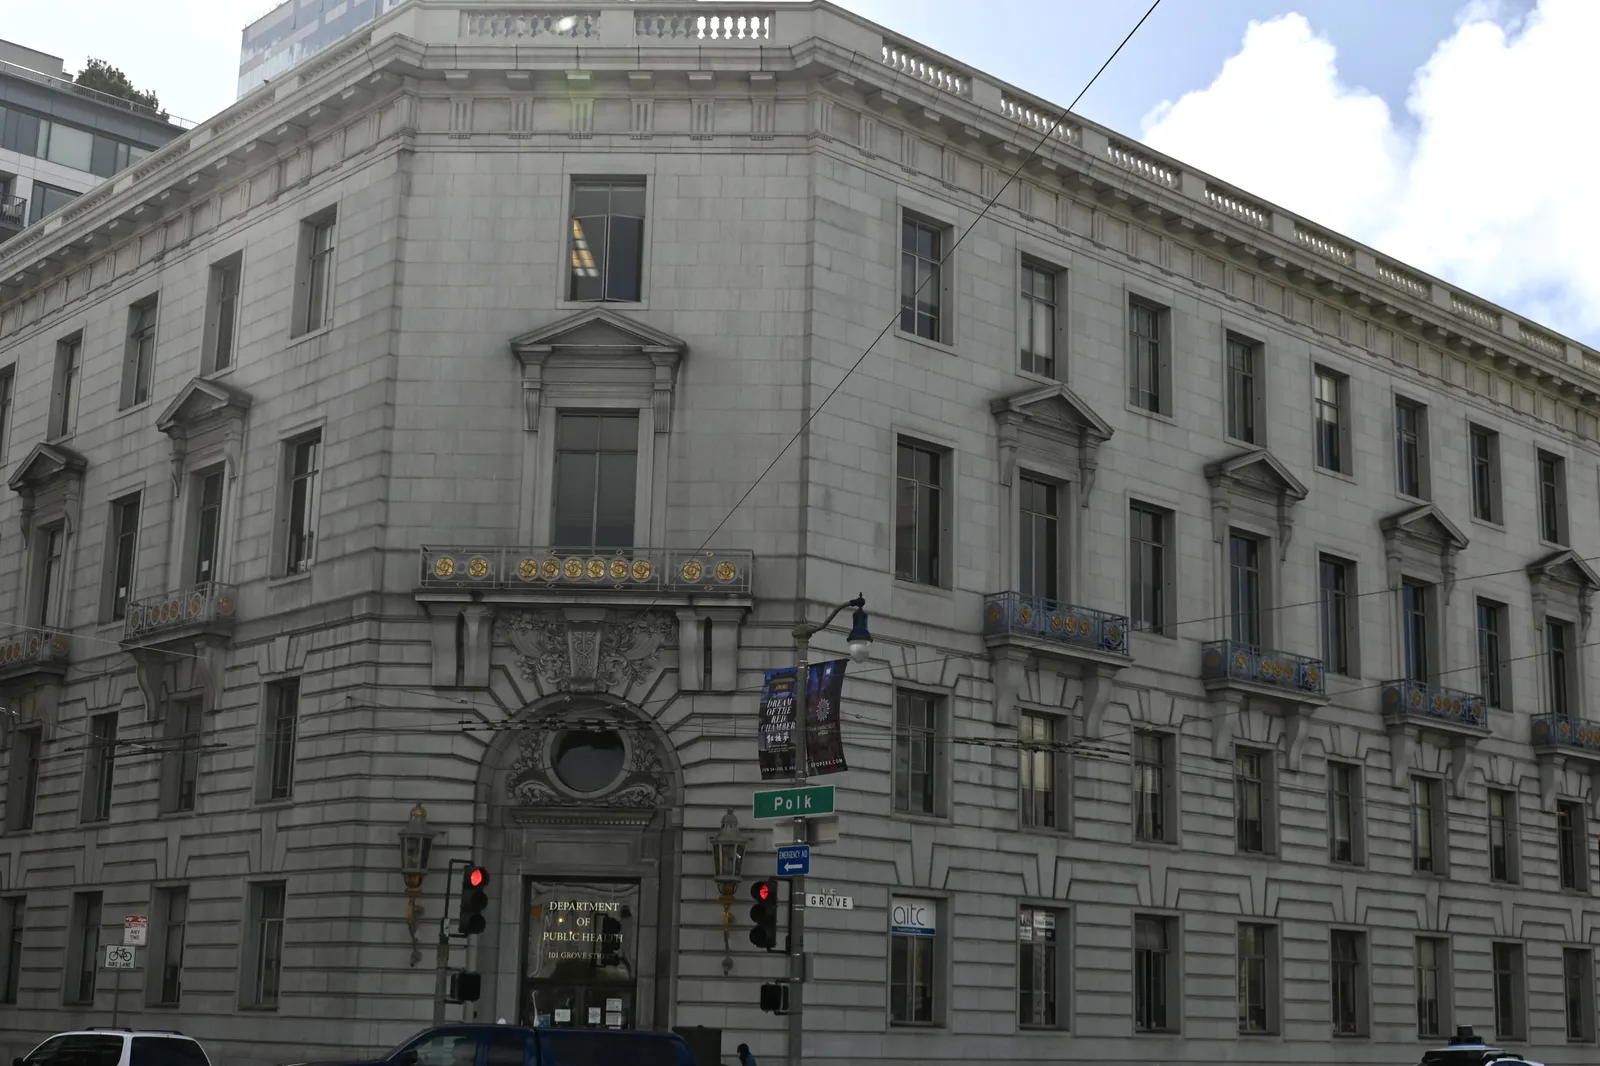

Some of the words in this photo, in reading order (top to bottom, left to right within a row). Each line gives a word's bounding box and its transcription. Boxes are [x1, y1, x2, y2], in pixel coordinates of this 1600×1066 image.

[767, 698, 793, 708] DREAM
[766, 707, 777, 716] OF
[777, 706, 792, 715] THE
[771, 715, 786, 724] RED
[760, 721, 796, 732] CHAMBER
[774, 794, 812, 811] Polk
[779, 850, 801, 859] EMERGENCY
[549, 901, 620, 912] DEPARTMENT
[811, 896, 847, 907] GROVE
[893, 904, 925, 926] aitc
[576, 917, 591, 926] OF
[543, 931, 580, 942] PUBLIC
[582, 933, 623, 943] HEALTH
[560, 951, 588, 959] GROVE
